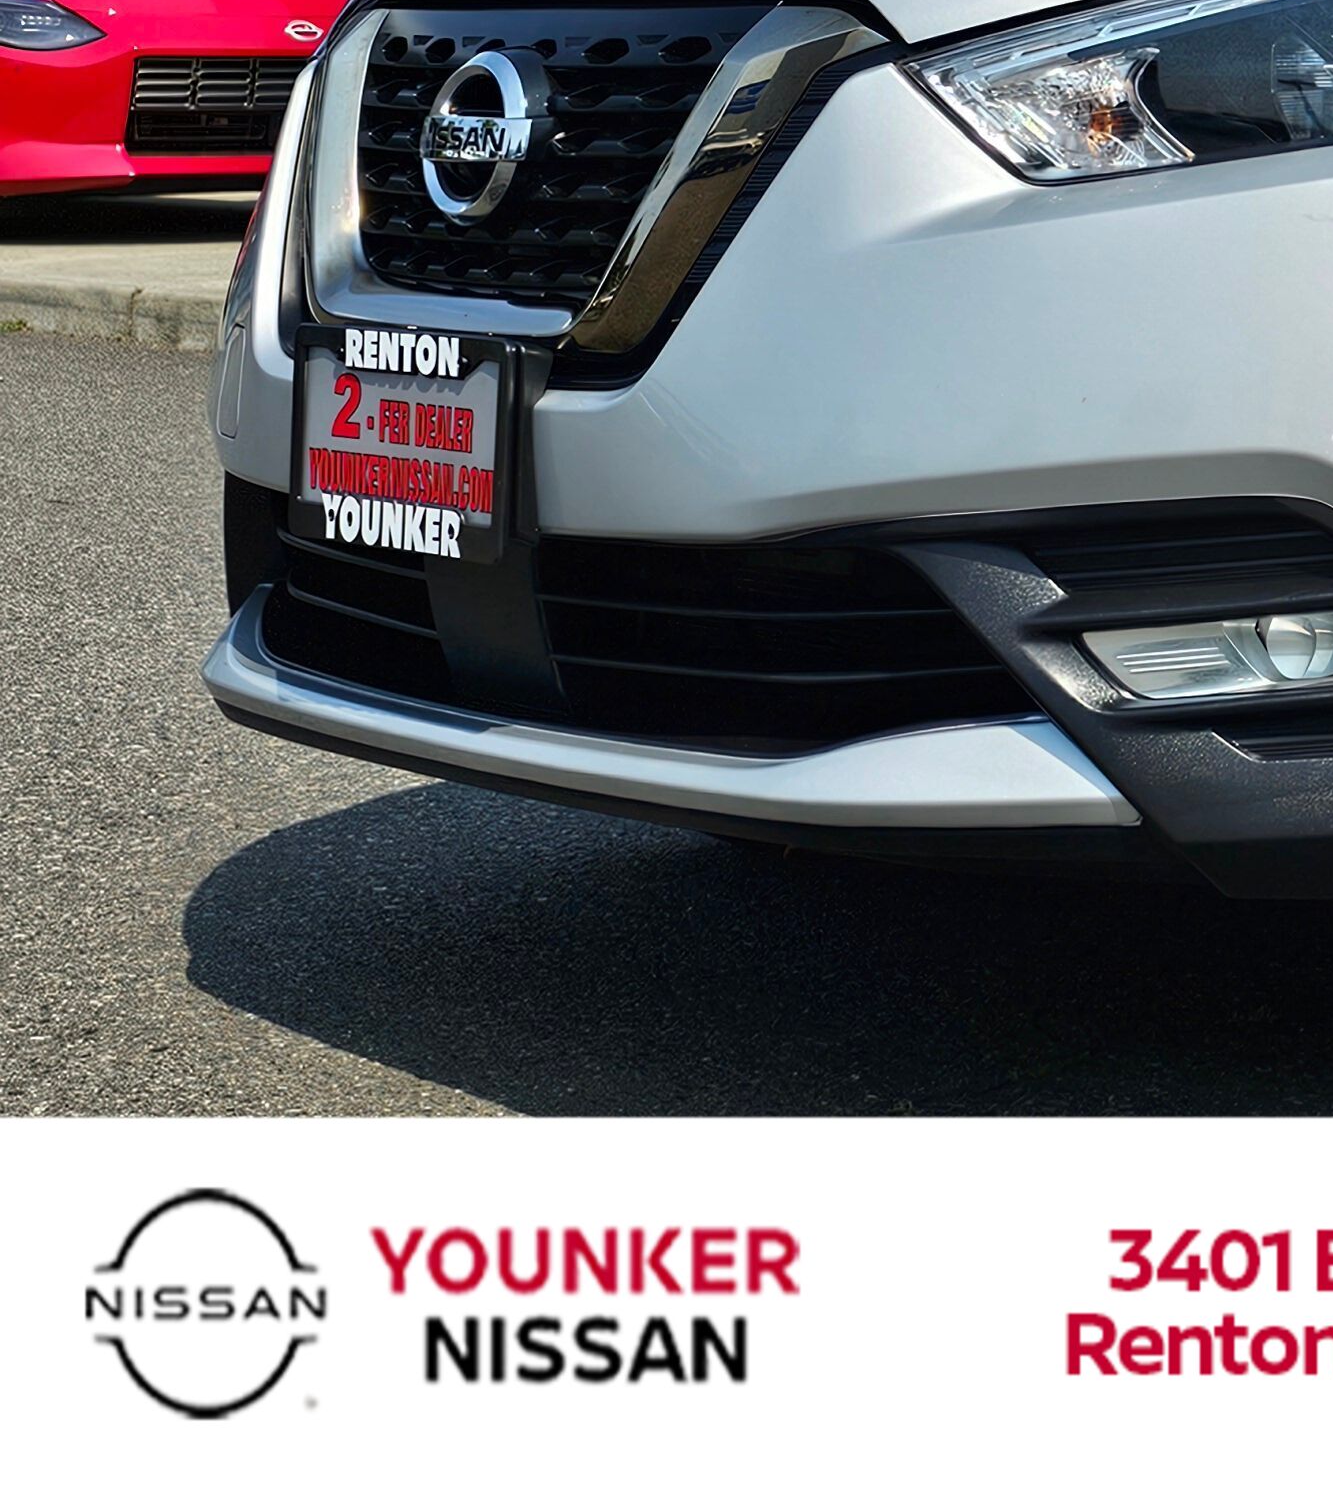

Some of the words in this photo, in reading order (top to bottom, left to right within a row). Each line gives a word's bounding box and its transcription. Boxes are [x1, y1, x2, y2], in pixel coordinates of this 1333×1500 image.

[344, 328, 461, 378] RENTON
[331, 372, 362, 440] 2
[414, 402, 474, 454] DEALER
[309, 447, 494, 514] YOUNKERNISSAN.COM
[321, 492, 462, 559] YOUNKER
